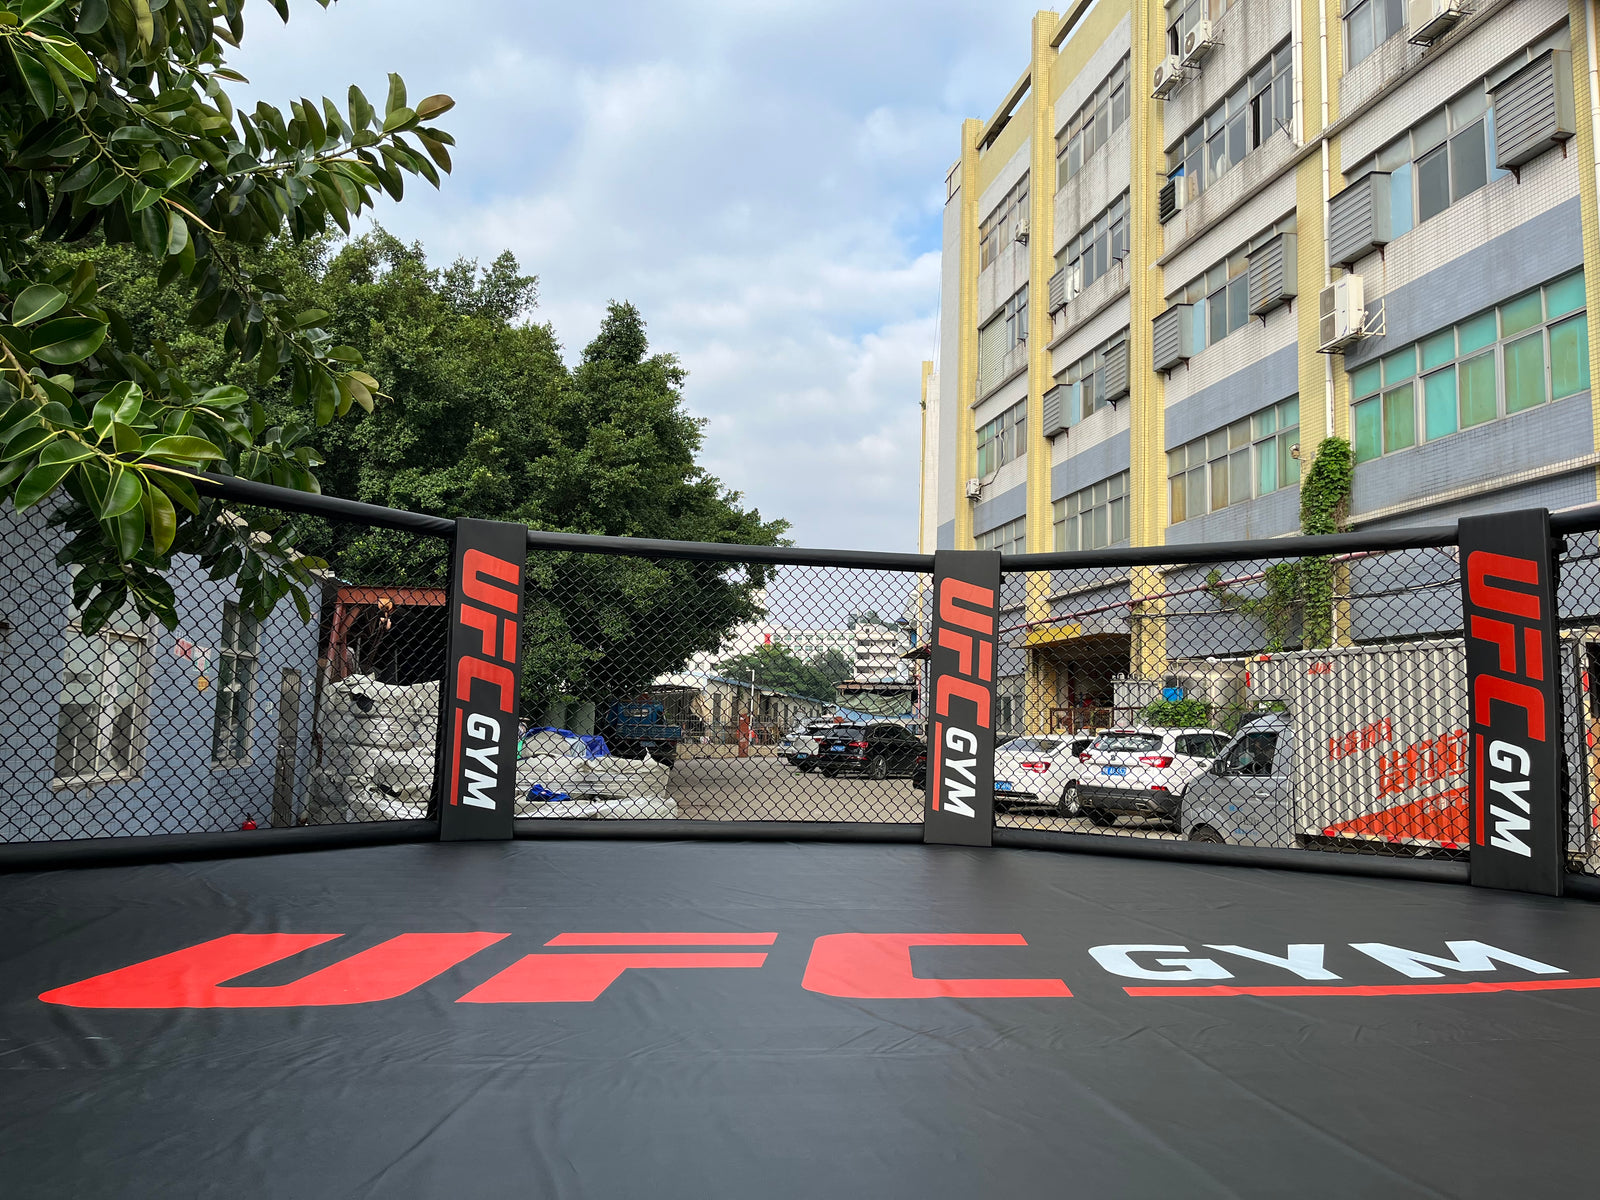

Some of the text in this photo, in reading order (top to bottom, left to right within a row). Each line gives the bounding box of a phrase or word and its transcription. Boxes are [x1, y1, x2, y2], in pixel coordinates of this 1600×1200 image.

[457, 549, 520, 810] UFC GYM
[935, 577, 994, 819] UFC GYM
[1467, 550, 1546, 858] UFC GYM
[38, 931, 1569, 1009] UFC GYM
